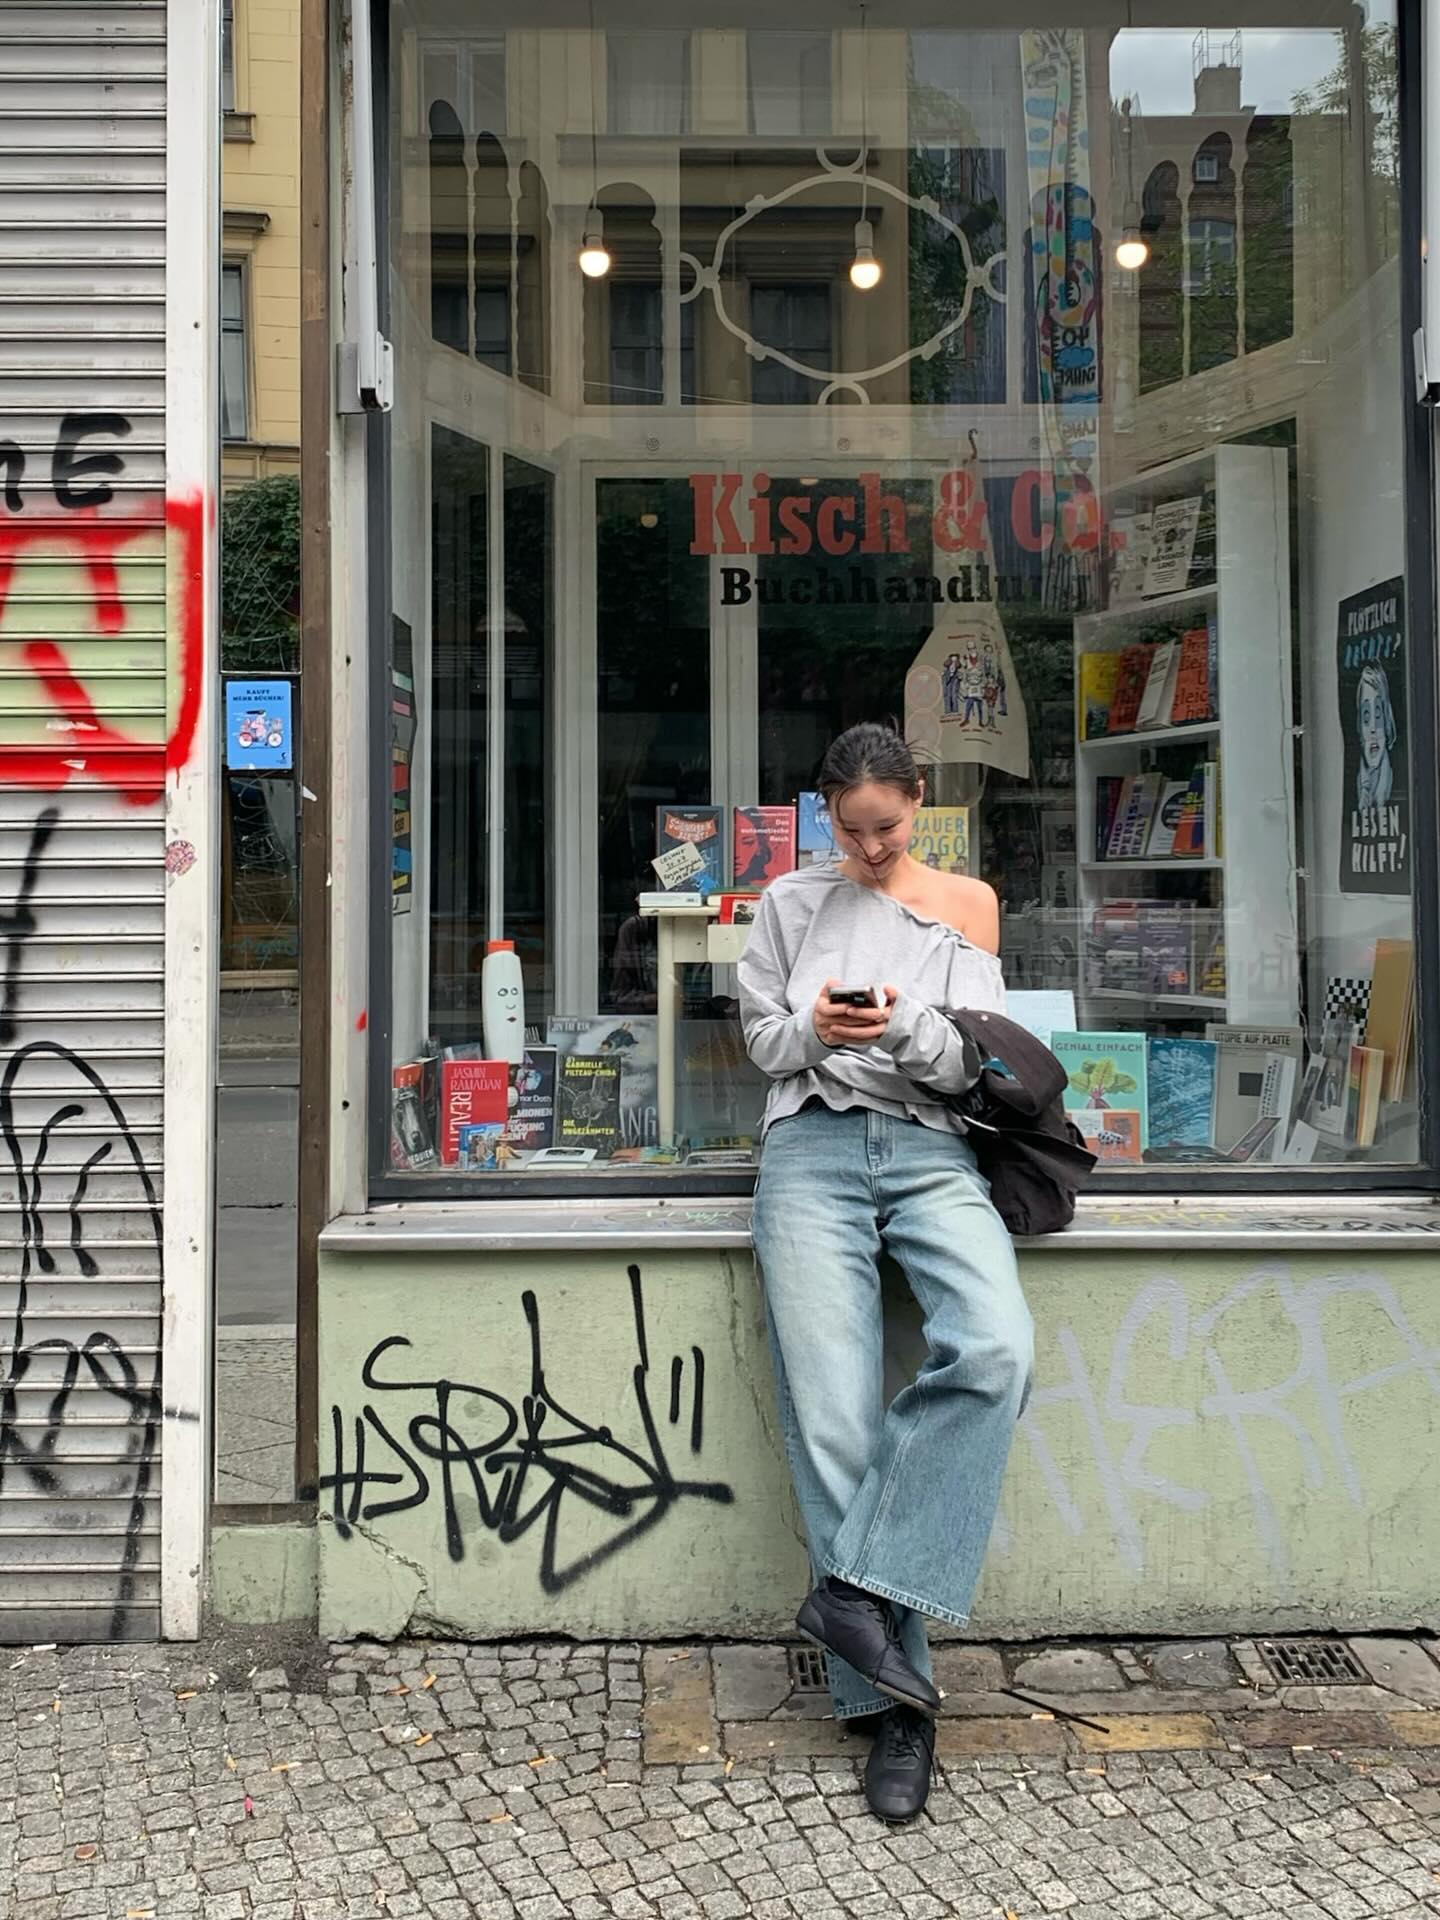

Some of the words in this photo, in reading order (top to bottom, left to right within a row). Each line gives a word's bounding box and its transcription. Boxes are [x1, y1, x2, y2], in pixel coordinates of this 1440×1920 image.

[689, 473, 911, 555] Kisch
[934, 471, 988, 552] &
[1011, 470, 1127, 553] Co.
[720, 564, 1093, 608] Buchhandlu
[1352, 805, 1400, 838] LESEN
[907, 835, 966, 856] POGO
[1352, 833, 1407, 873] HILFT!
[1055, 1042, 1093, 1051] GENIAL
[1096, 1043, 1143, 1052] EINFACH
[1215, 1032, 1242, 1044] UTOPIE
[1244, 1033, 1261, 1045] AUF
[1262, 1034, 1291, 1047] PLATTE
[565, 1060, 603, 1069] GABRIELLE
[450, 1066, 487, 1079] JASMIN
[450, 1078, 502, 1091] RAMADAN
[562, 1119, 575, 1127] DIE
